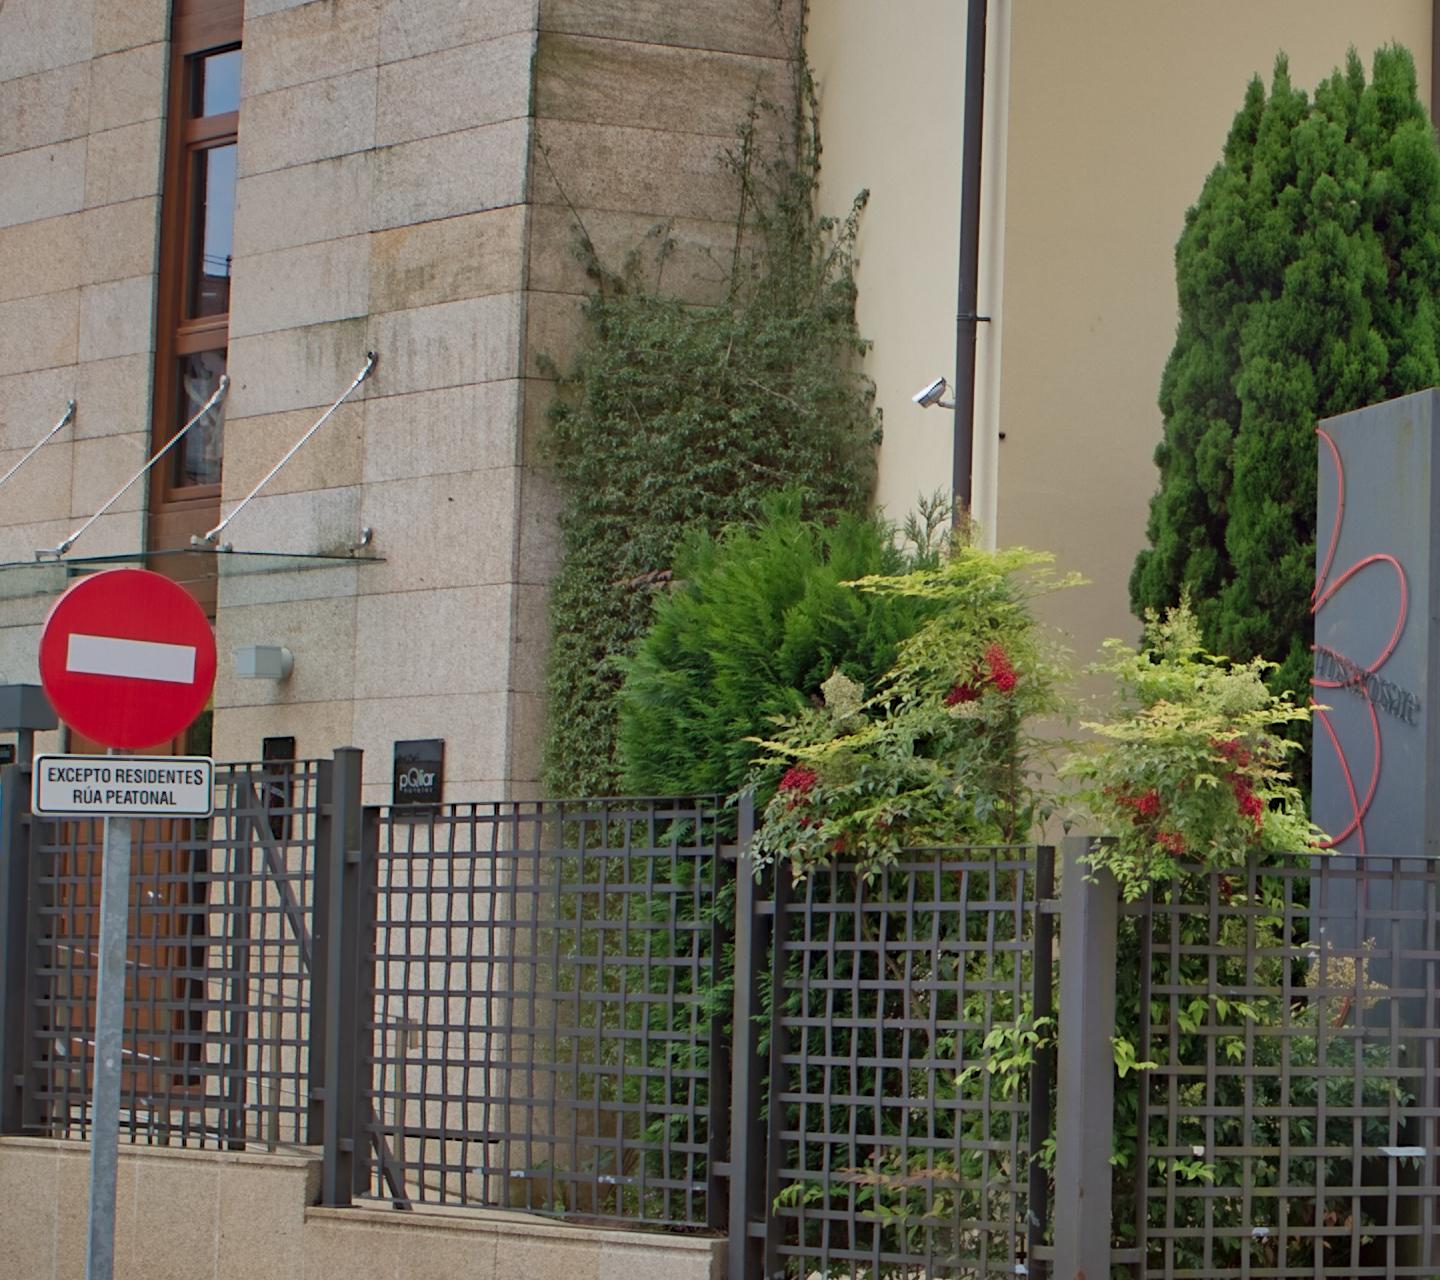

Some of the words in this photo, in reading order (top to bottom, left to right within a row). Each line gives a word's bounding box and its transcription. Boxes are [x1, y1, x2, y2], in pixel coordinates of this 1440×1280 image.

[47, 767, 112, 784] EXCEPTO
[115, 768, 204, 786] RESIDENTES
[73, 785, 103, 804] RÚA
[105, 789, 177, 806] PEATONAL
